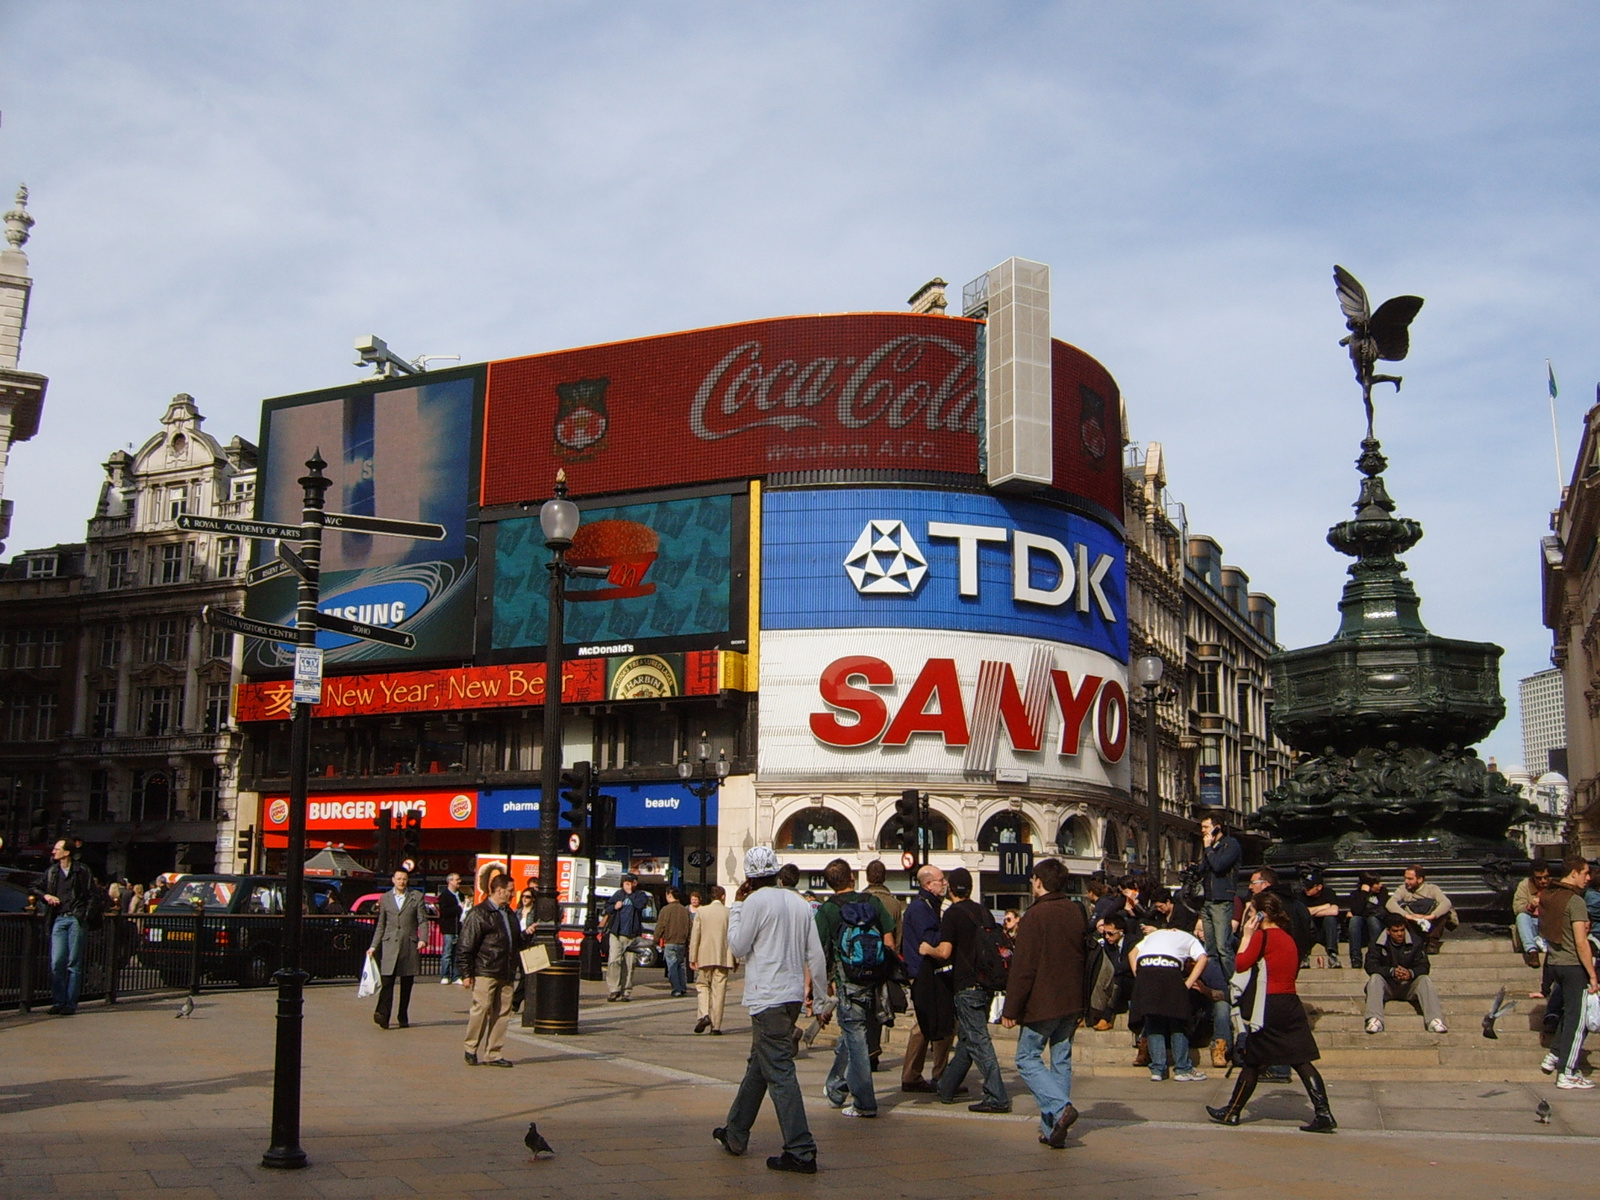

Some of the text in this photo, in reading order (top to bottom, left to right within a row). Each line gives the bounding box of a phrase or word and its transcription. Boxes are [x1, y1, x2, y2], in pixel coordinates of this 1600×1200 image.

[193, 519, 301, 538] ROYAL ACADEMY OF ARTS
[324, 516, 343, 526] W/C
[927, 520, 1117, 623] TDK
[239, 621, 268, 635] VISITORS
[268, 628, 299, 640] CENTRE
[352, 624, 371, 636] SOHO
[578, 644, 635, 656] McDonald's
[326, 683, 376, 708] New
[379, 679, 440, 708] Year,
[448, 675, 501, 701] New
[507, 669, 574, 697] Ber
[626, 675, 662, 691] HARBIN
[808, 643, 1129, 772] SANYO
[309, 801, 376, 820] BURGER
[503, 802, 539, 813] pharma
[645, 797, 680, 810] beauty
[1005, 852, 1029, 876] GAP
